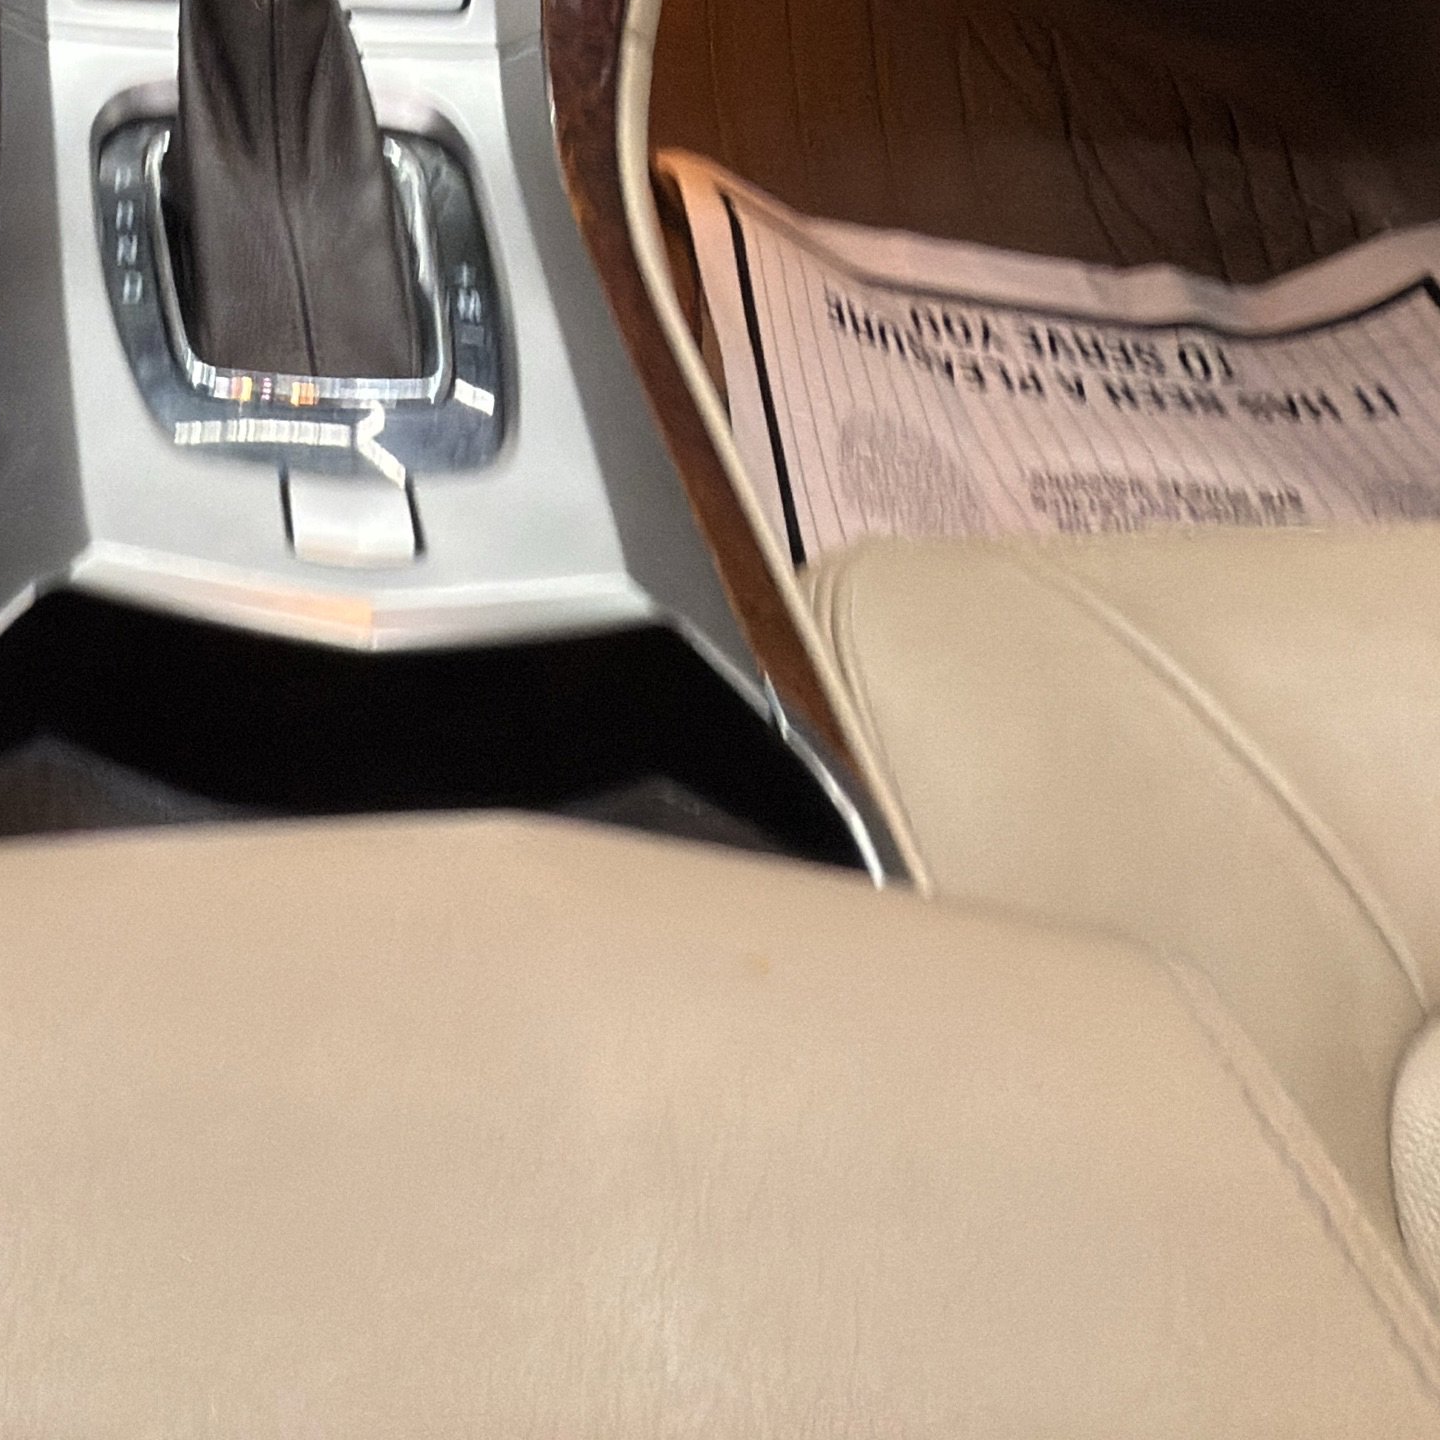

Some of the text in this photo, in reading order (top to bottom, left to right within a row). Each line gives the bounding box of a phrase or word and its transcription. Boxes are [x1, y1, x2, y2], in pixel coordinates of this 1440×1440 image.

[826, 292, 1046, 399] PLEASURE
[907, 306, 1236, 383] TO SERVE YOU
[1052, 366, 1087, 404] A
[1103, 377, 1227, 418] BEEN
